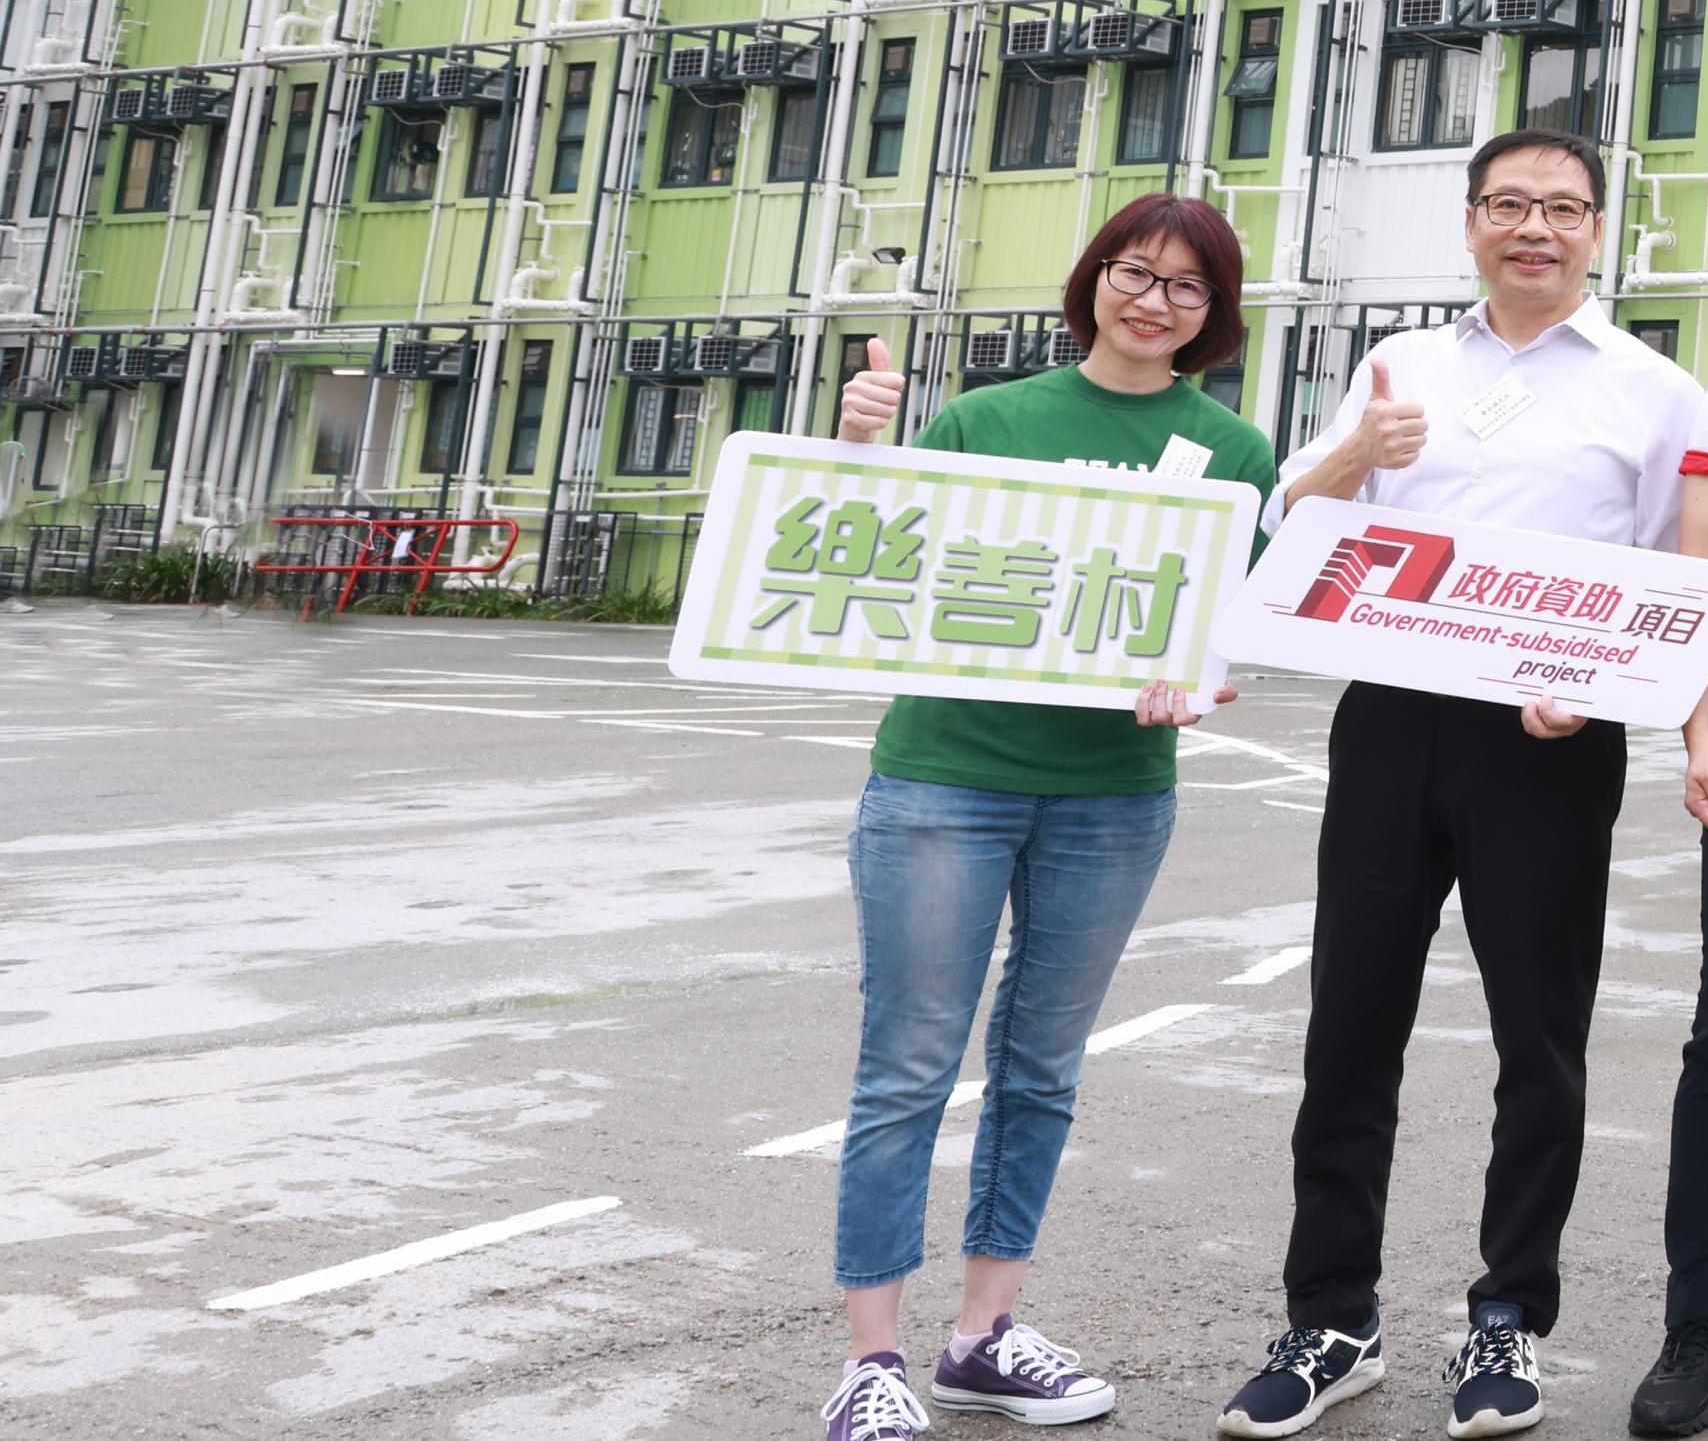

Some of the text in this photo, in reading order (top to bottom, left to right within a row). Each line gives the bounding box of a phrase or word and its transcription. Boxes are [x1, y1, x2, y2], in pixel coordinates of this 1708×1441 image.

[750, 496, 1187, 656] 樂善村
[1350, 603, 1639, 665] Government-subsidised
[1513, 659, 1597, 686] project
